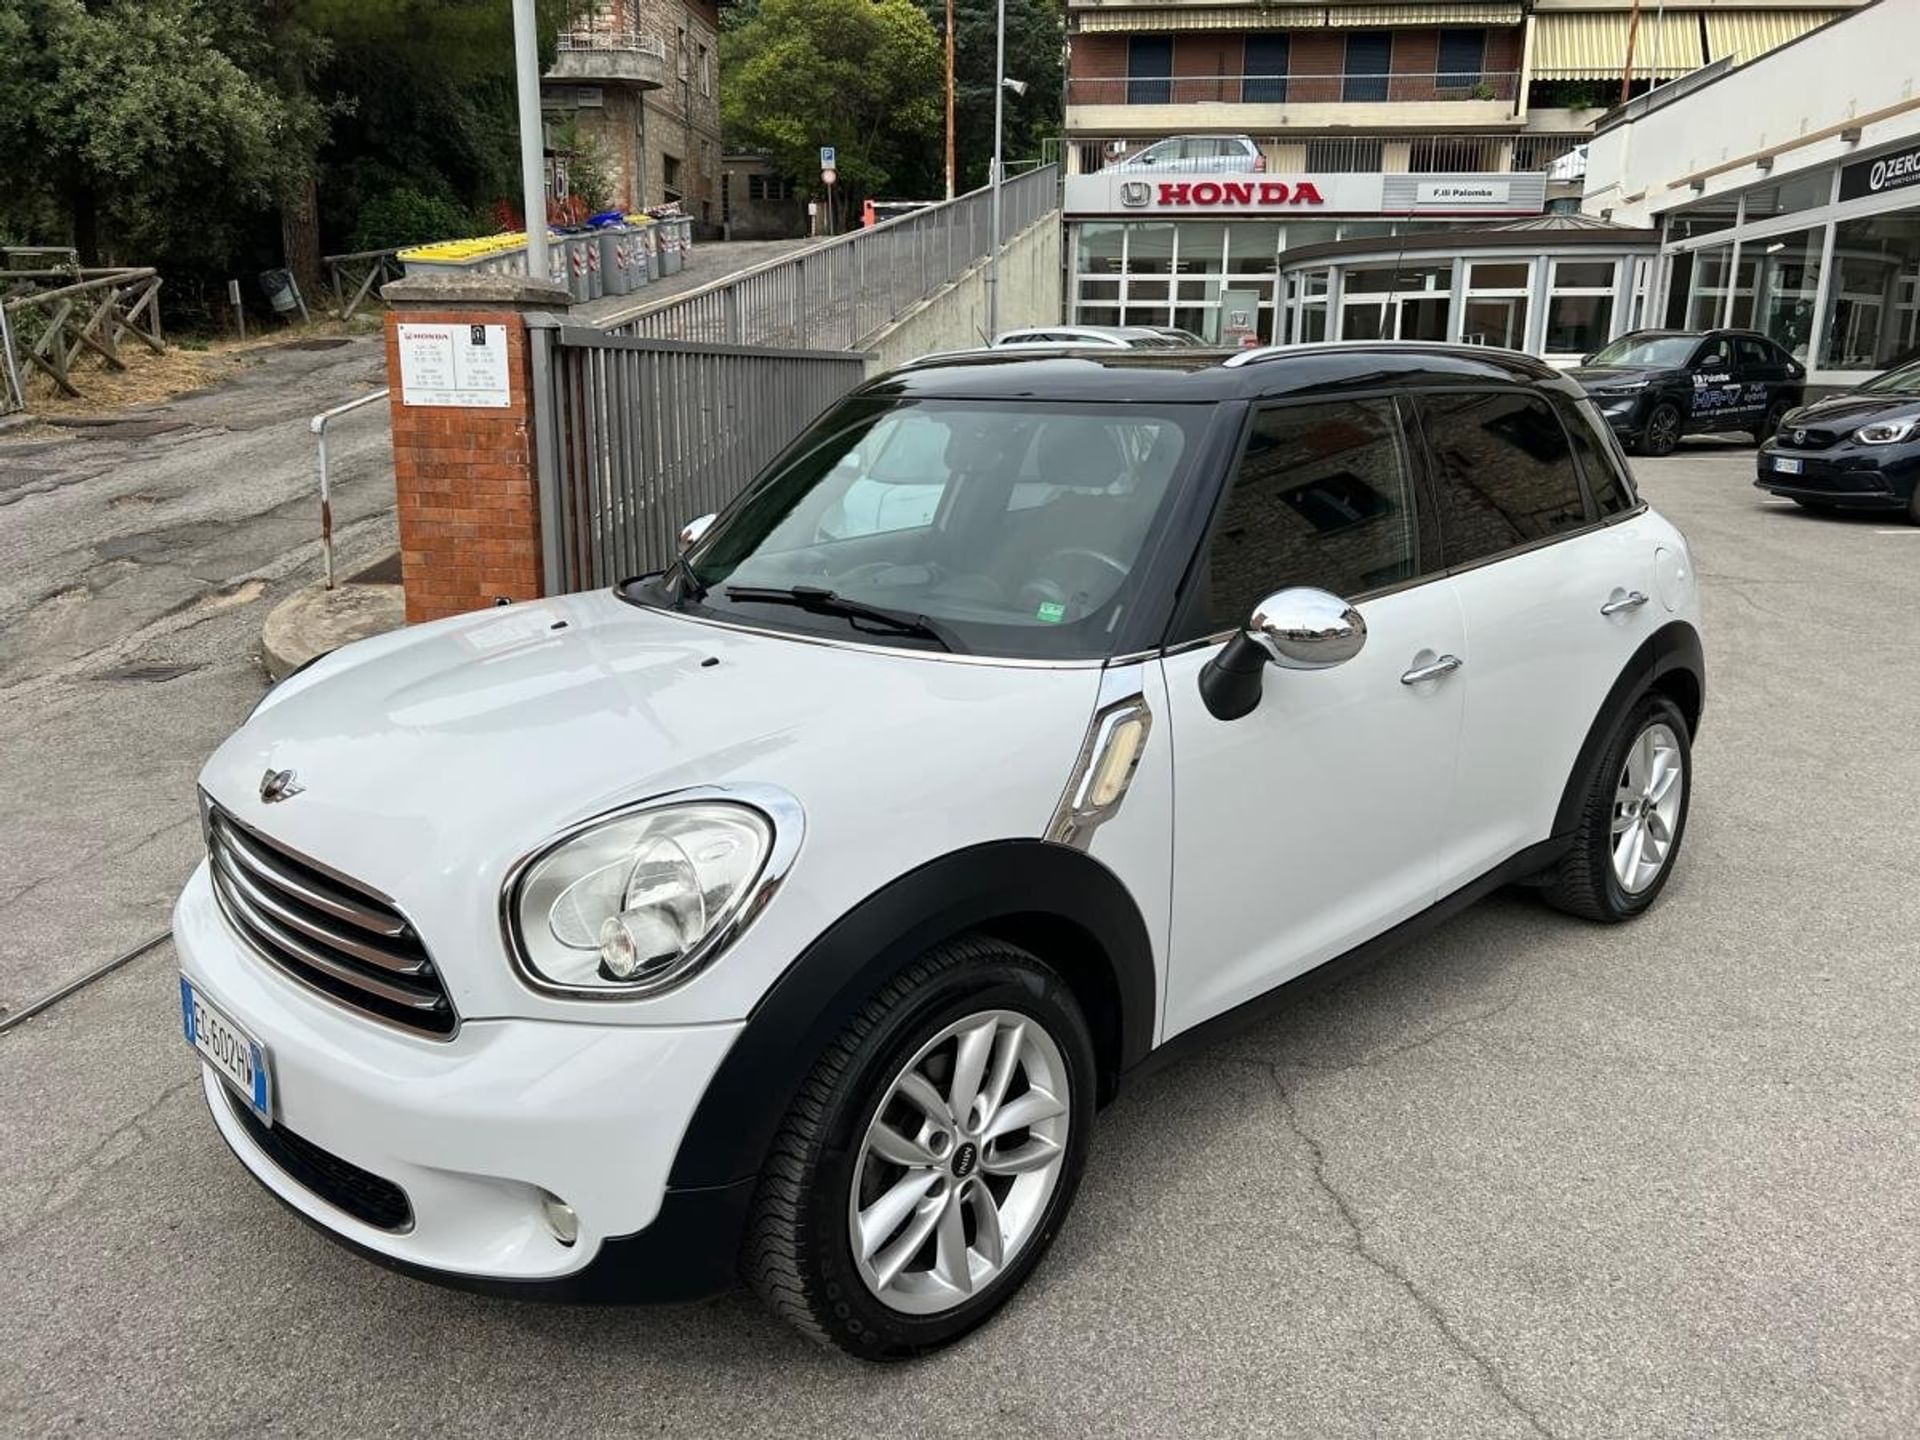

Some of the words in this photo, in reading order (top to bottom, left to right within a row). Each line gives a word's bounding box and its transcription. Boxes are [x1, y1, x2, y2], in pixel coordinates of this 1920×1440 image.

[1158, 182, 1324, 206] HONDA
[413, 332, 448, 340] HONDA
[958, 1146, 973, 1174] MINI
